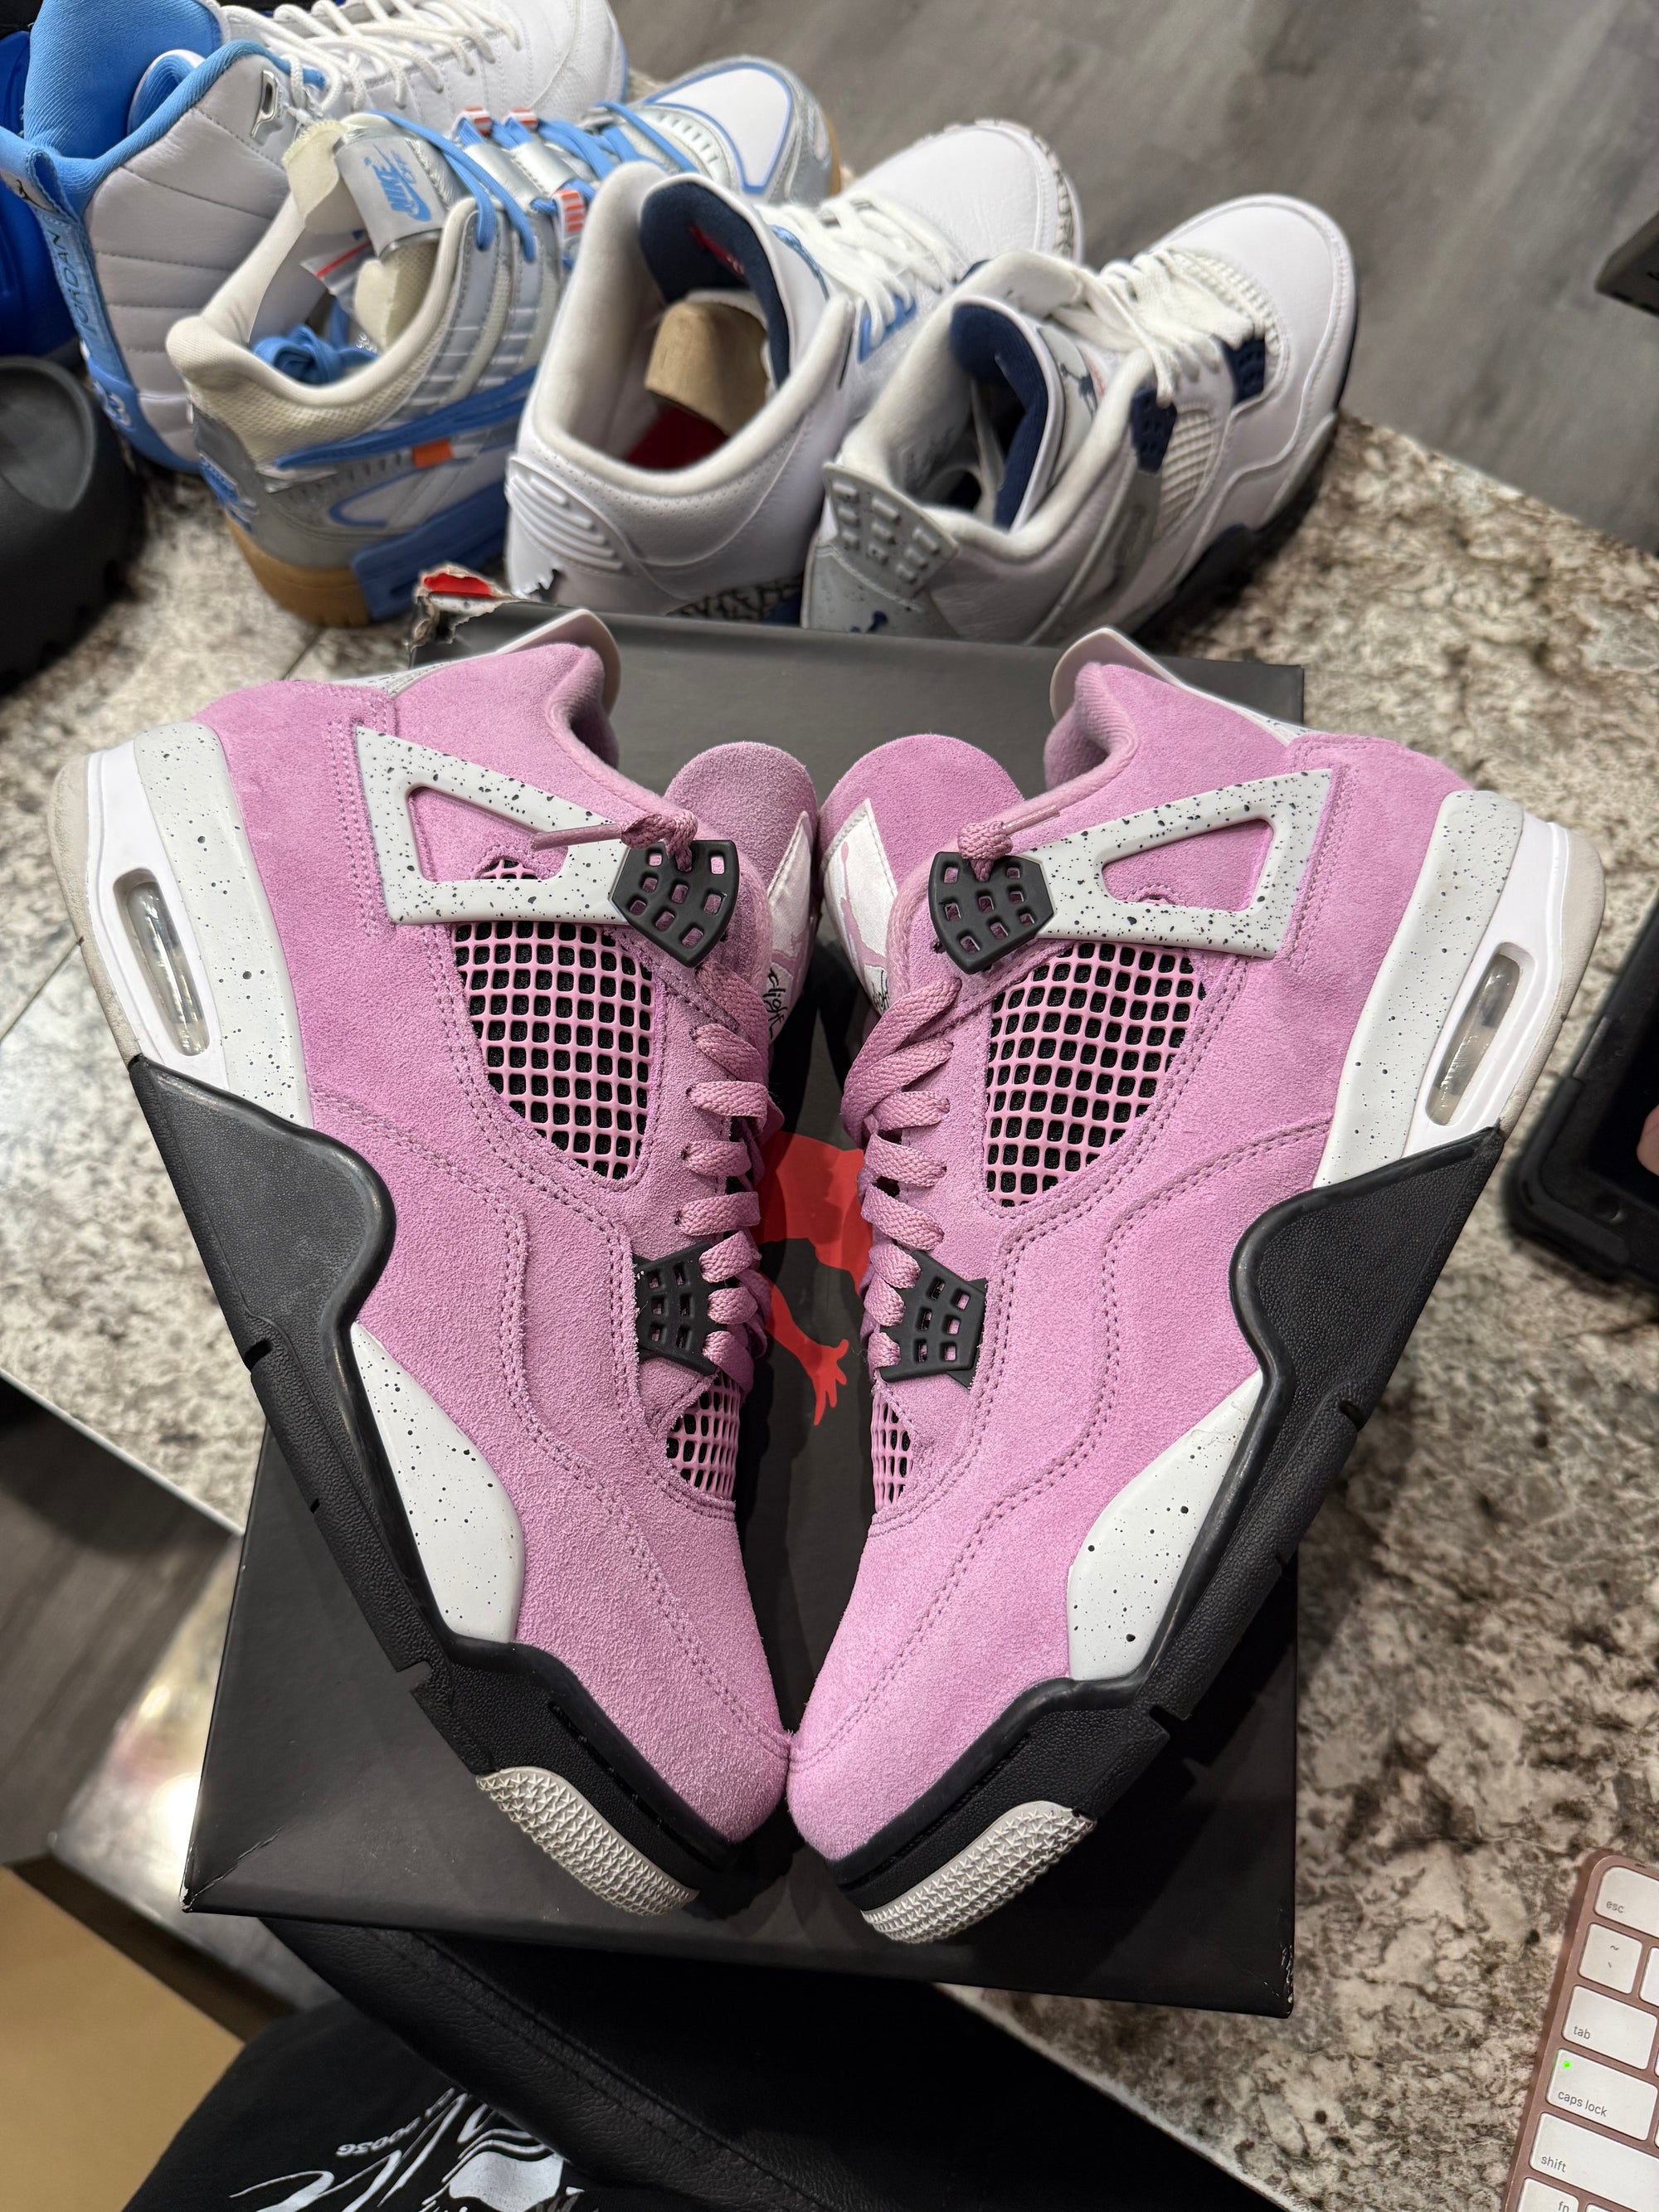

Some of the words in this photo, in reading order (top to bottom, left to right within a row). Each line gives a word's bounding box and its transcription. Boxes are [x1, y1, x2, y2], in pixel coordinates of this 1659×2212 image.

[1606, 1900, 1624, 1913] esc
[1574, 2025, 1591, 2039] tab
[1558, 2091, 1583, 2107] caps
[1585, 2100, 1608, 2117] lock
[1540, 2156, 1567, 2172] shift
[1558, 2201, 1569, 2212] fn
